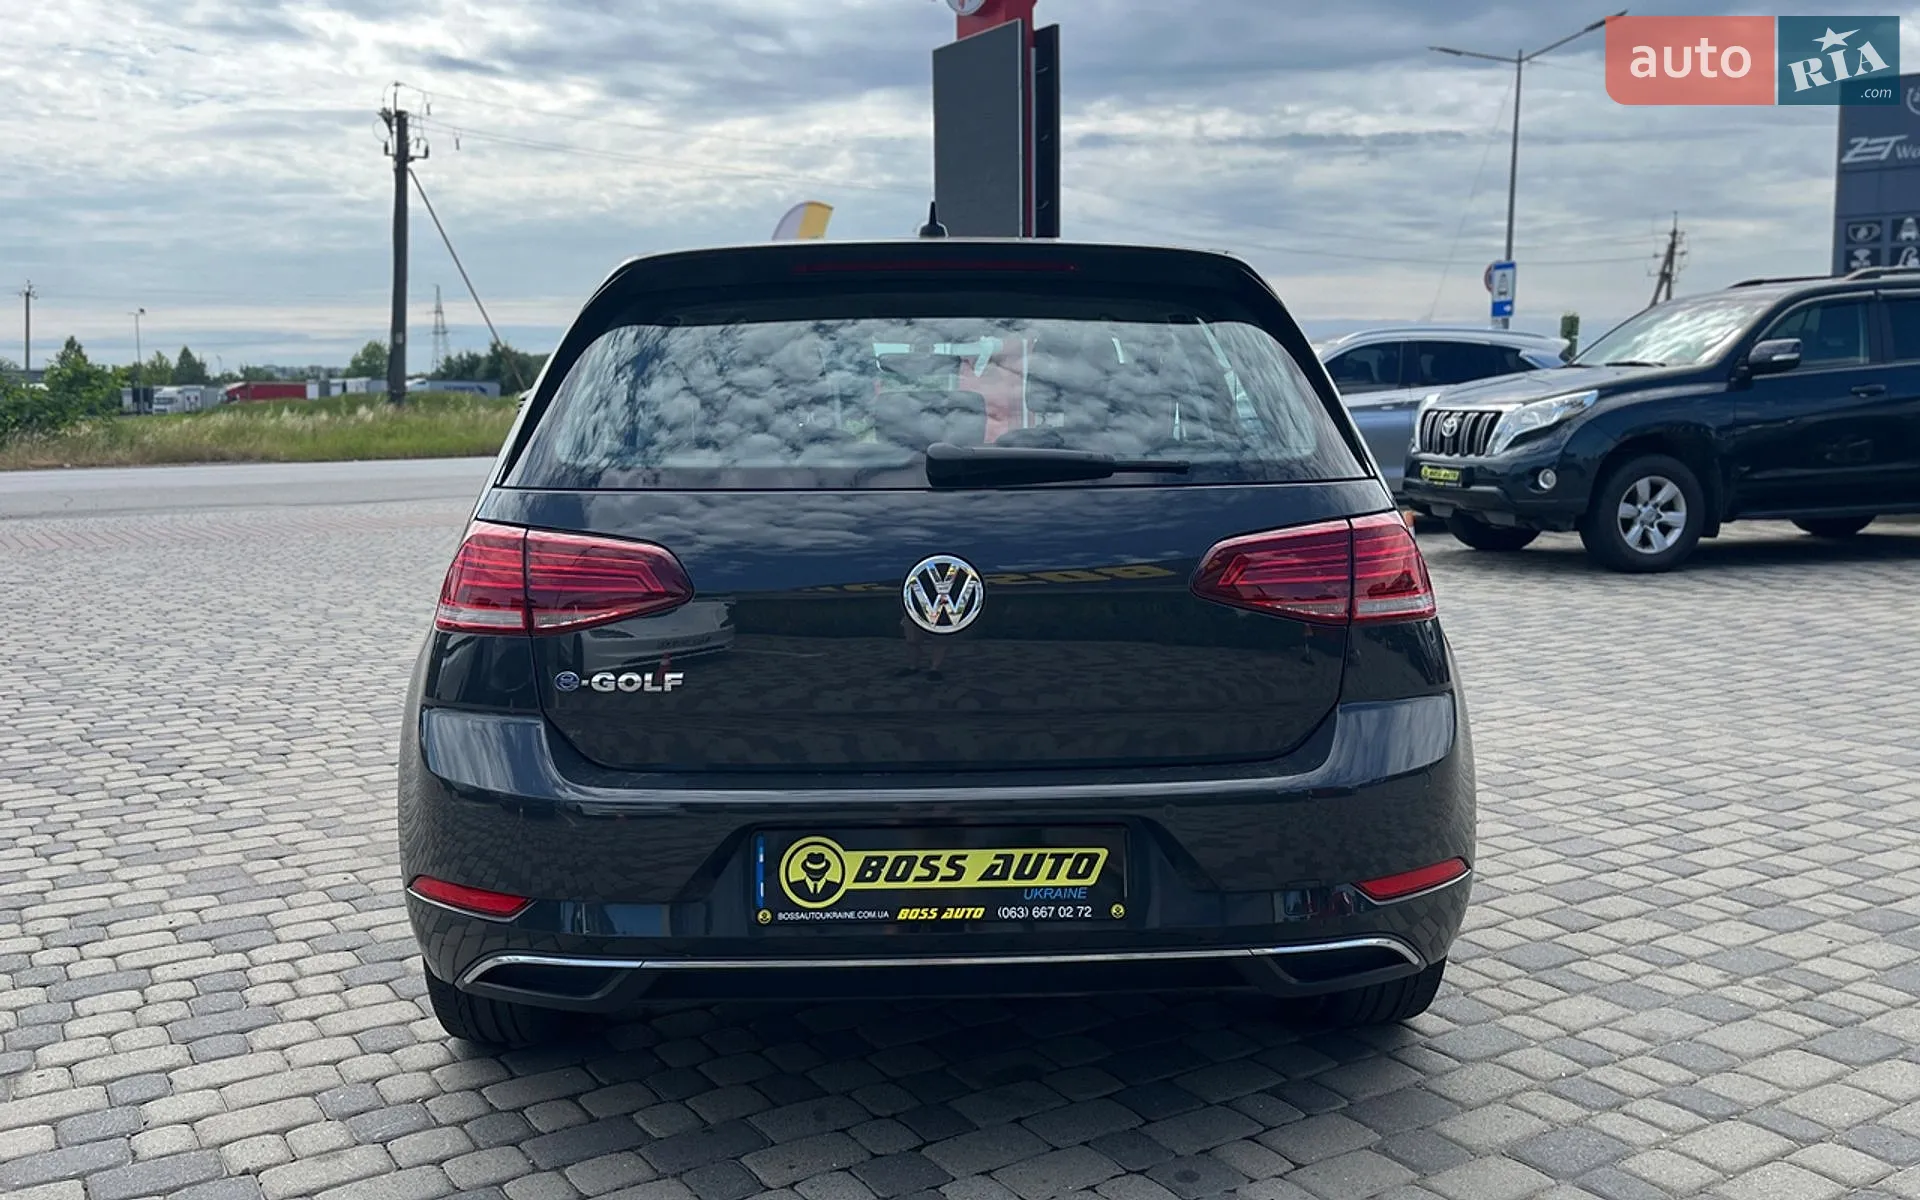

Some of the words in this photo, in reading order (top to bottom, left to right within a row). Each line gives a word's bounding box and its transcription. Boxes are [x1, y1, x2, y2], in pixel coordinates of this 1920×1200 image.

[852, 854, 969, 884] BOSS
[976, 852, 1101, 882] AUTO
[1023, 887, 1089, 900] UKRAINE
[776, 910, 890, 922] BOSSAUTOUKRAINE.COM.UA
[897, 907, 938, 921] BOSS
[941, 907, 985, 920] AUTO
[997, 905, 1029, 919] (063)
[1031, 905, 1055, 918] 667
[1057, 906, 1074, 918] 02
[1076, 905, 1093, 918] 72
